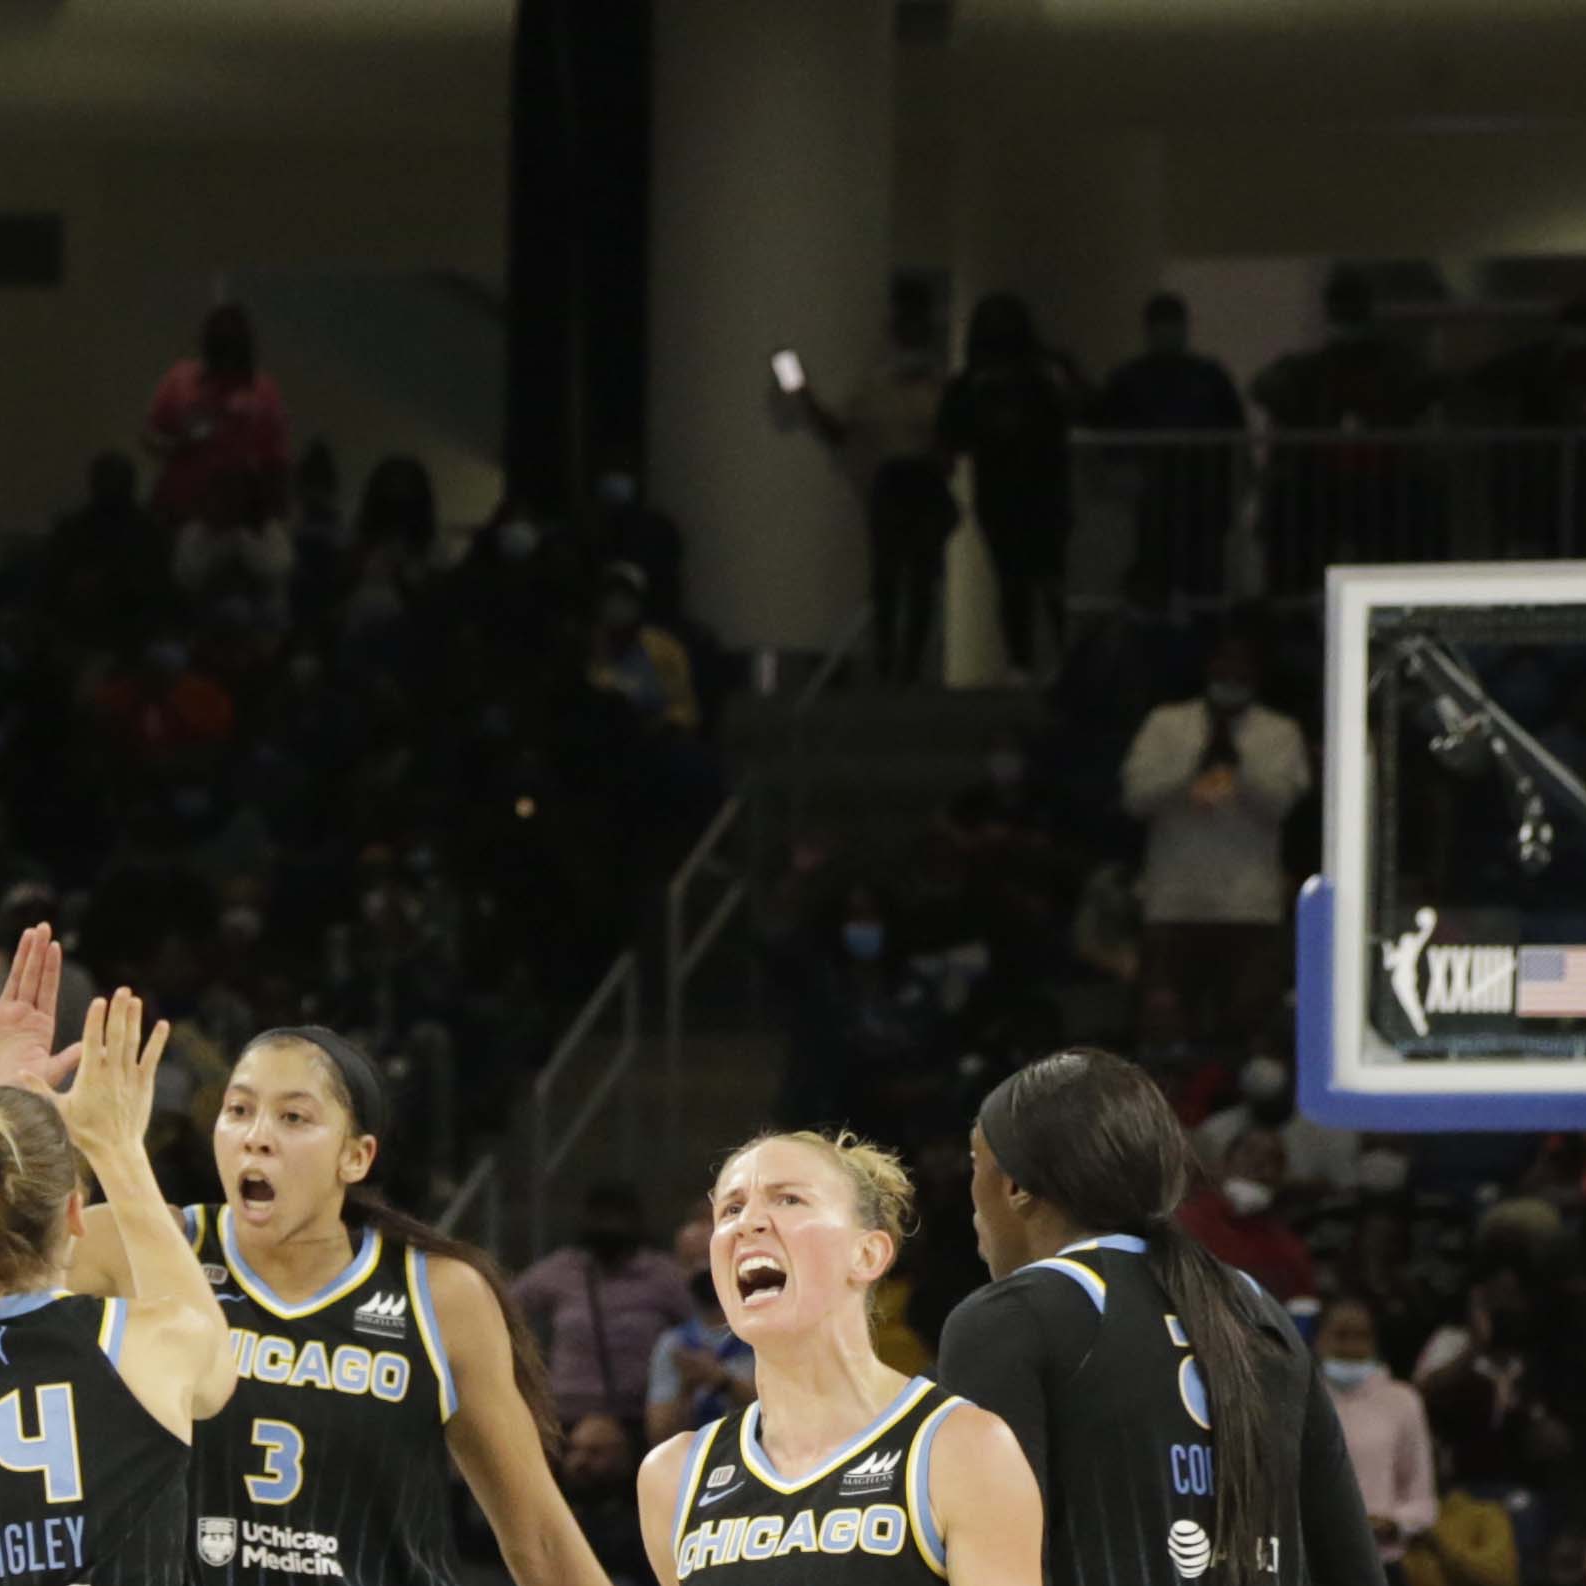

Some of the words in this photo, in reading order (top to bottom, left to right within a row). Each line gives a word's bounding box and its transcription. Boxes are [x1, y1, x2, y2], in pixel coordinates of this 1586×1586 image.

[227, 1328, 410, 1403] ICAGO
[243, 1418, 304, 1505] 3
[242, 1520, 338, 1554] UChicago
[677, 1503, 907, 1580] CHICAGO
